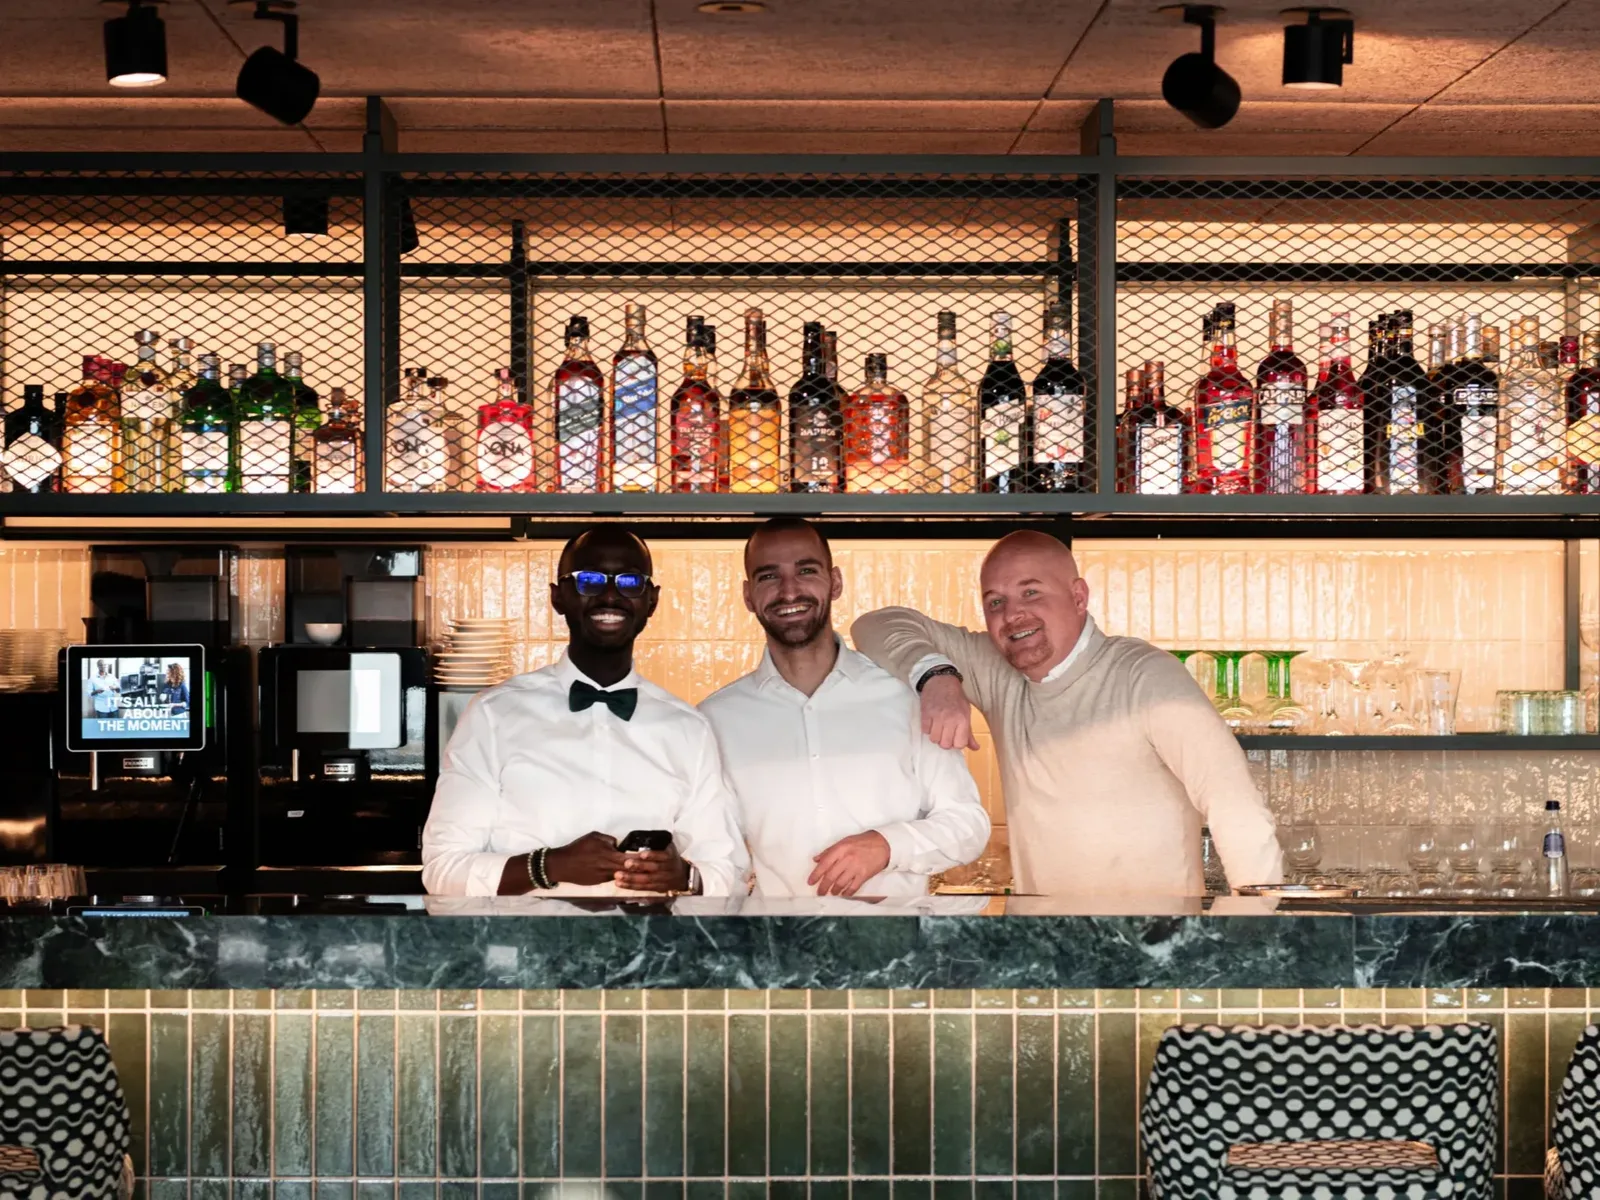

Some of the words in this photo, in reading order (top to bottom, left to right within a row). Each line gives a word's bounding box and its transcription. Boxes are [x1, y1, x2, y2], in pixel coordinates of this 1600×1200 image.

[107, 696, 132, 708] IT'S
[134, 696, 159, 708] ALL
[122, 707, 171, 720] ABOUT
[97, 719, 125, 732] THE
[127, 719, 190, 731] MOMENT
